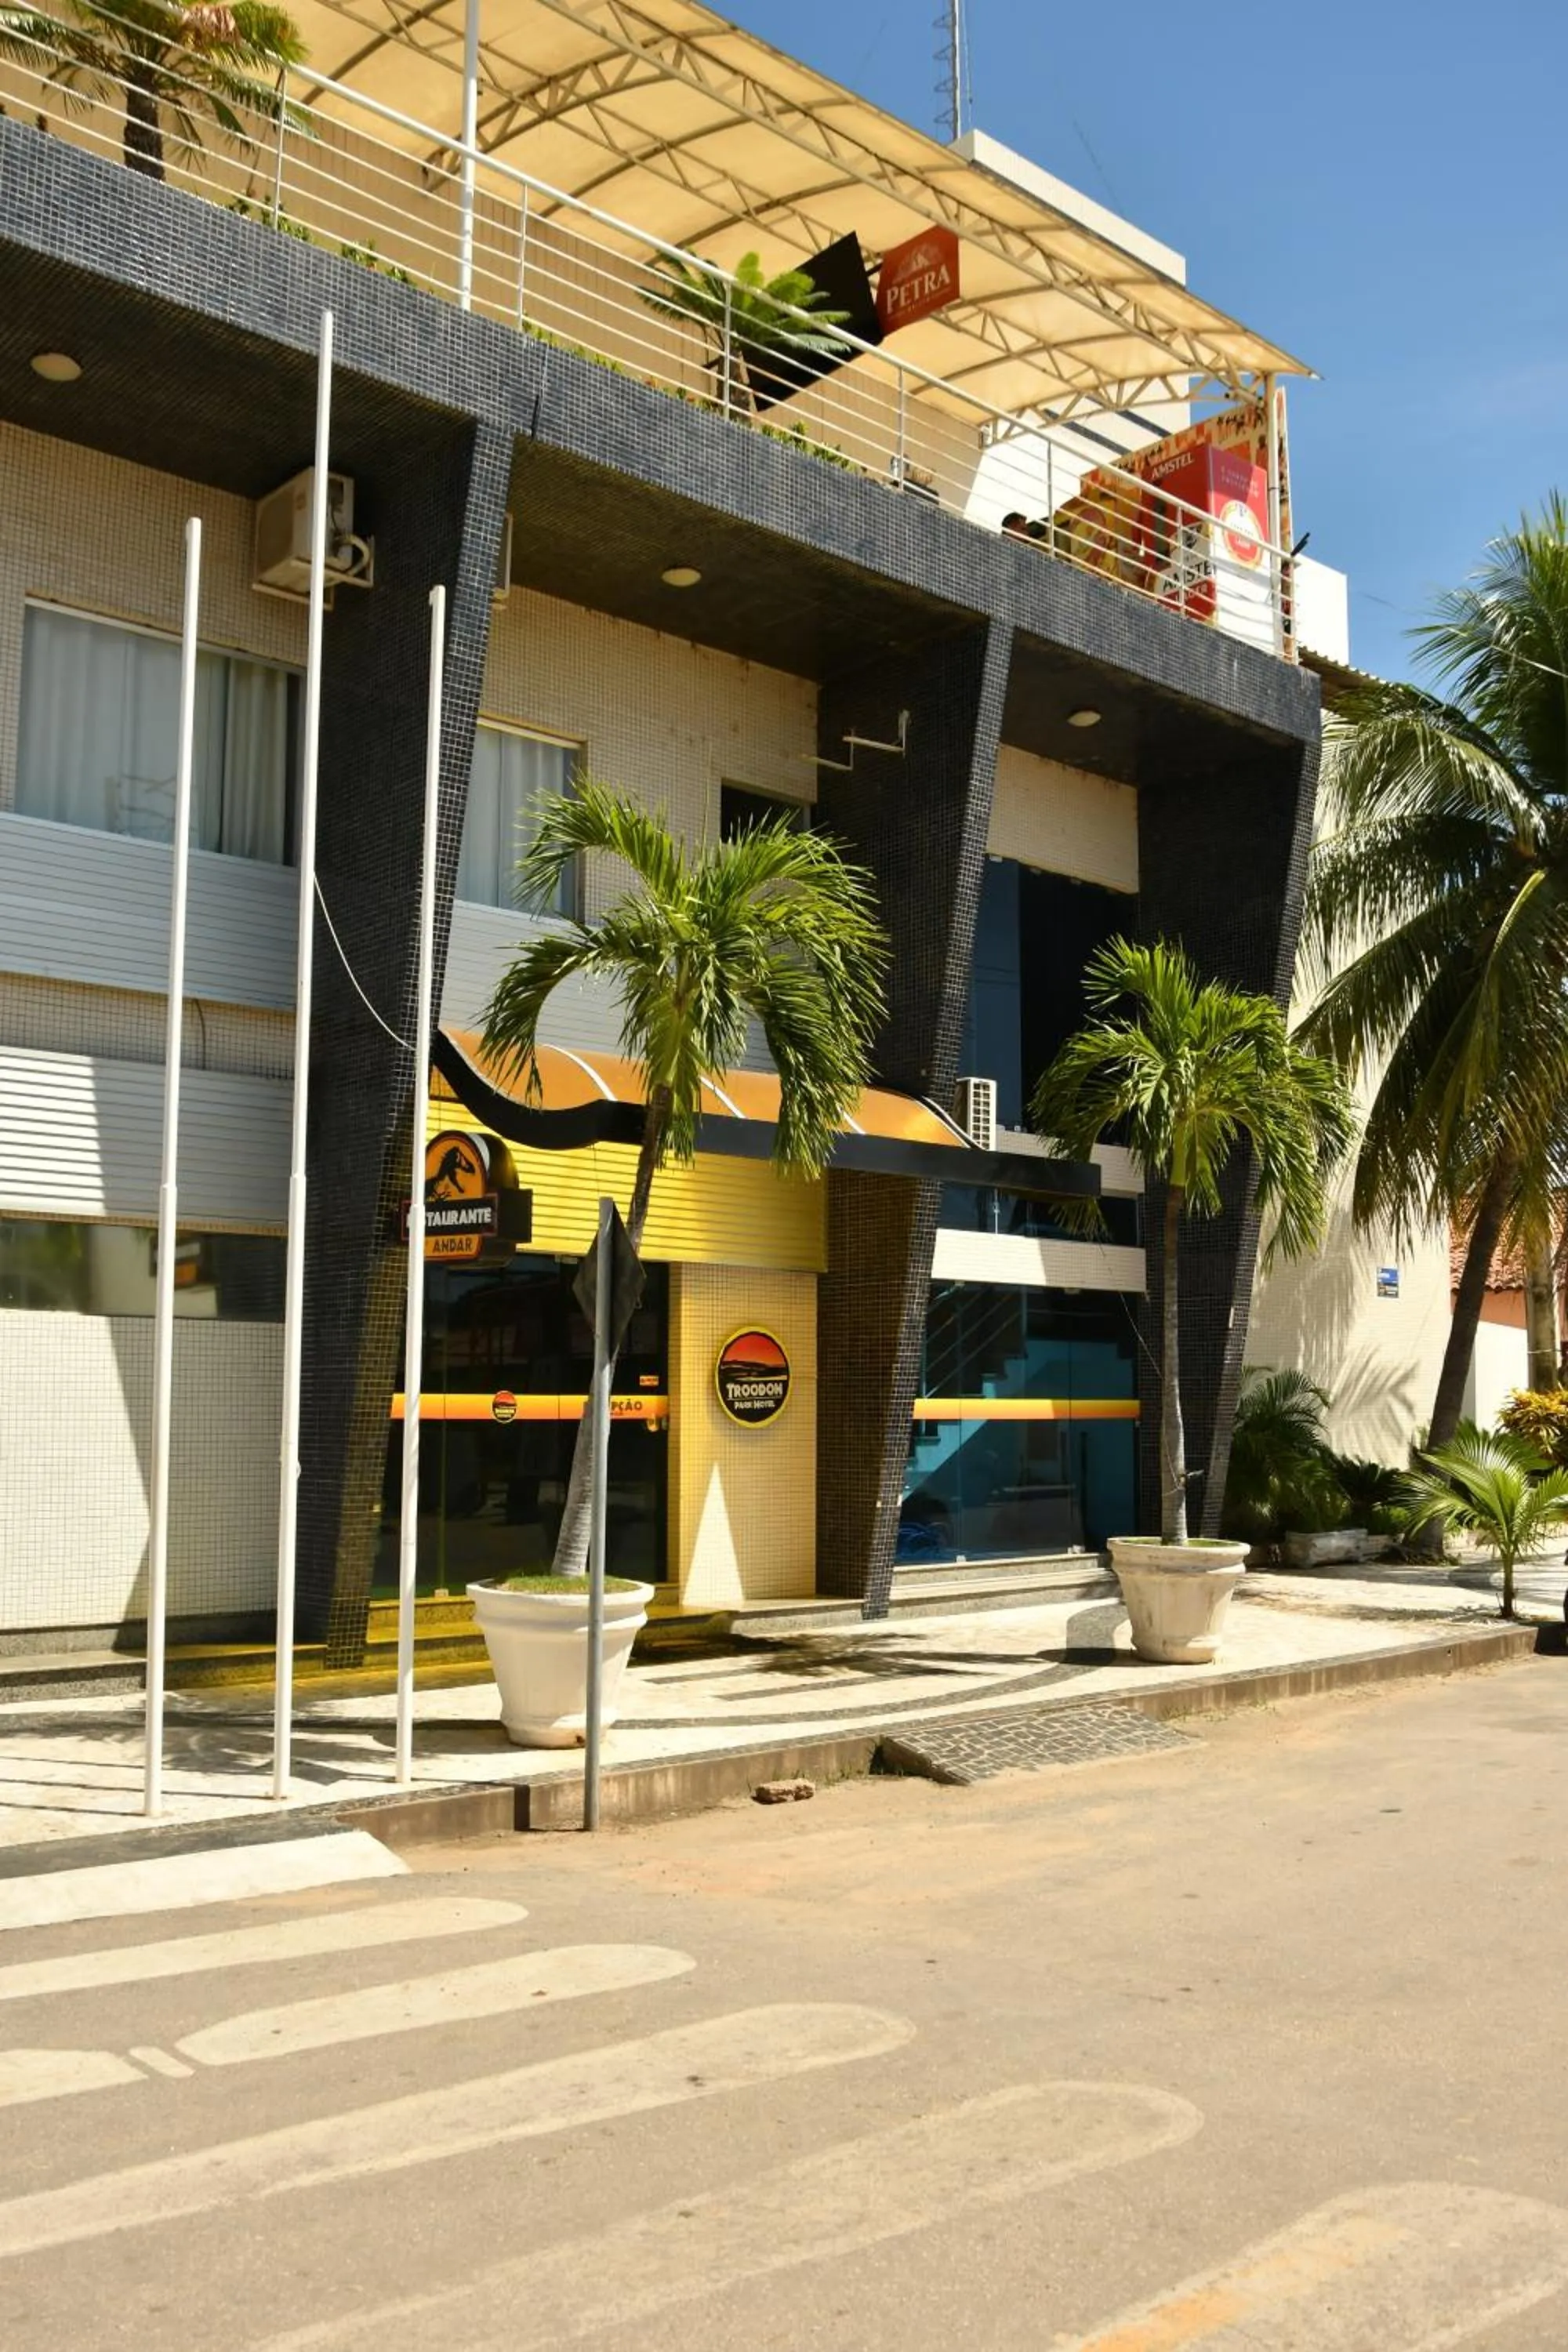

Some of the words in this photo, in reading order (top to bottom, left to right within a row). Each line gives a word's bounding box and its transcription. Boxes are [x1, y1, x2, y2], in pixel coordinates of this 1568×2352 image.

[886, 263, 950, 314] PETRA
[1151, 452, 1196, 480] AMSTEL
[406, 1207, 492, 1229] TAURANTE
[432, 1238, 473, 1254] ANDAR
[726, 1382, 783, 1399] TROODON
[734, 1401, 753, 1410] PARK
[753, 1399, 775, 1409] HOTEL
